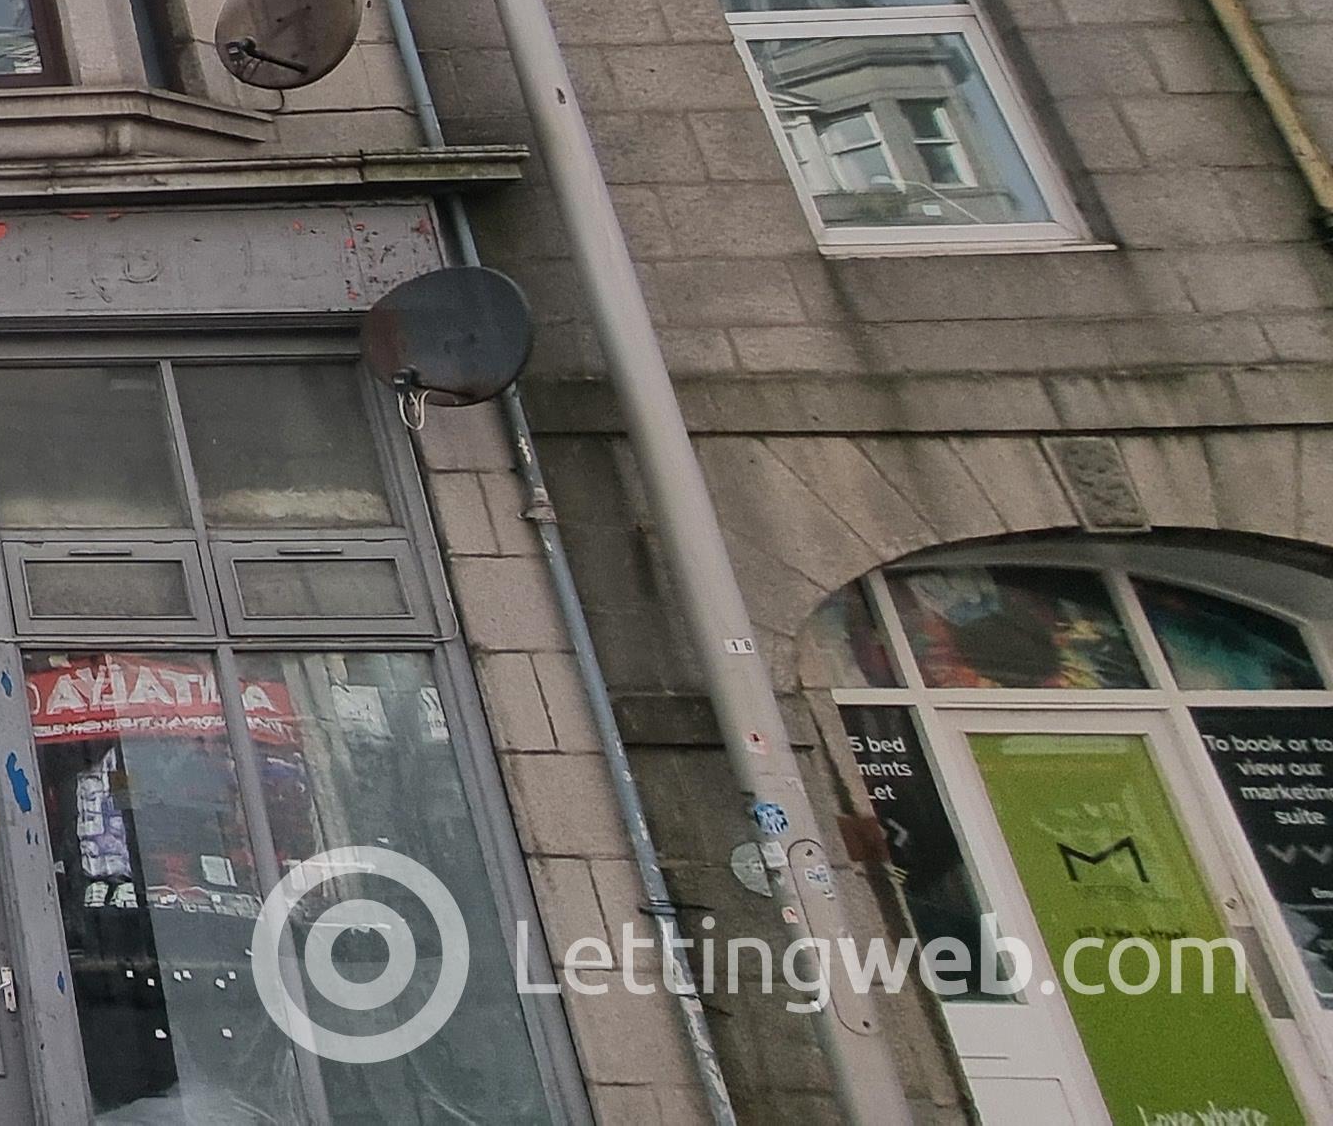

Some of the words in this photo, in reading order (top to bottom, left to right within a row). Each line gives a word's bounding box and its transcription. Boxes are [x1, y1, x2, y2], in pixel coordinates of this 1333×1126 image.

[866, 735, 907, 753] bed
[1201, 734, 1230, 752] To
[1229, 734, 1288, 752] book
[1287, 738, 1310, 752] or
[1312, 736, 1333, 752] to
[1236, 758, 1285, 776] view
[1287, 762, 1325, 776] our
[1274, 807, 1327, 825] suite
